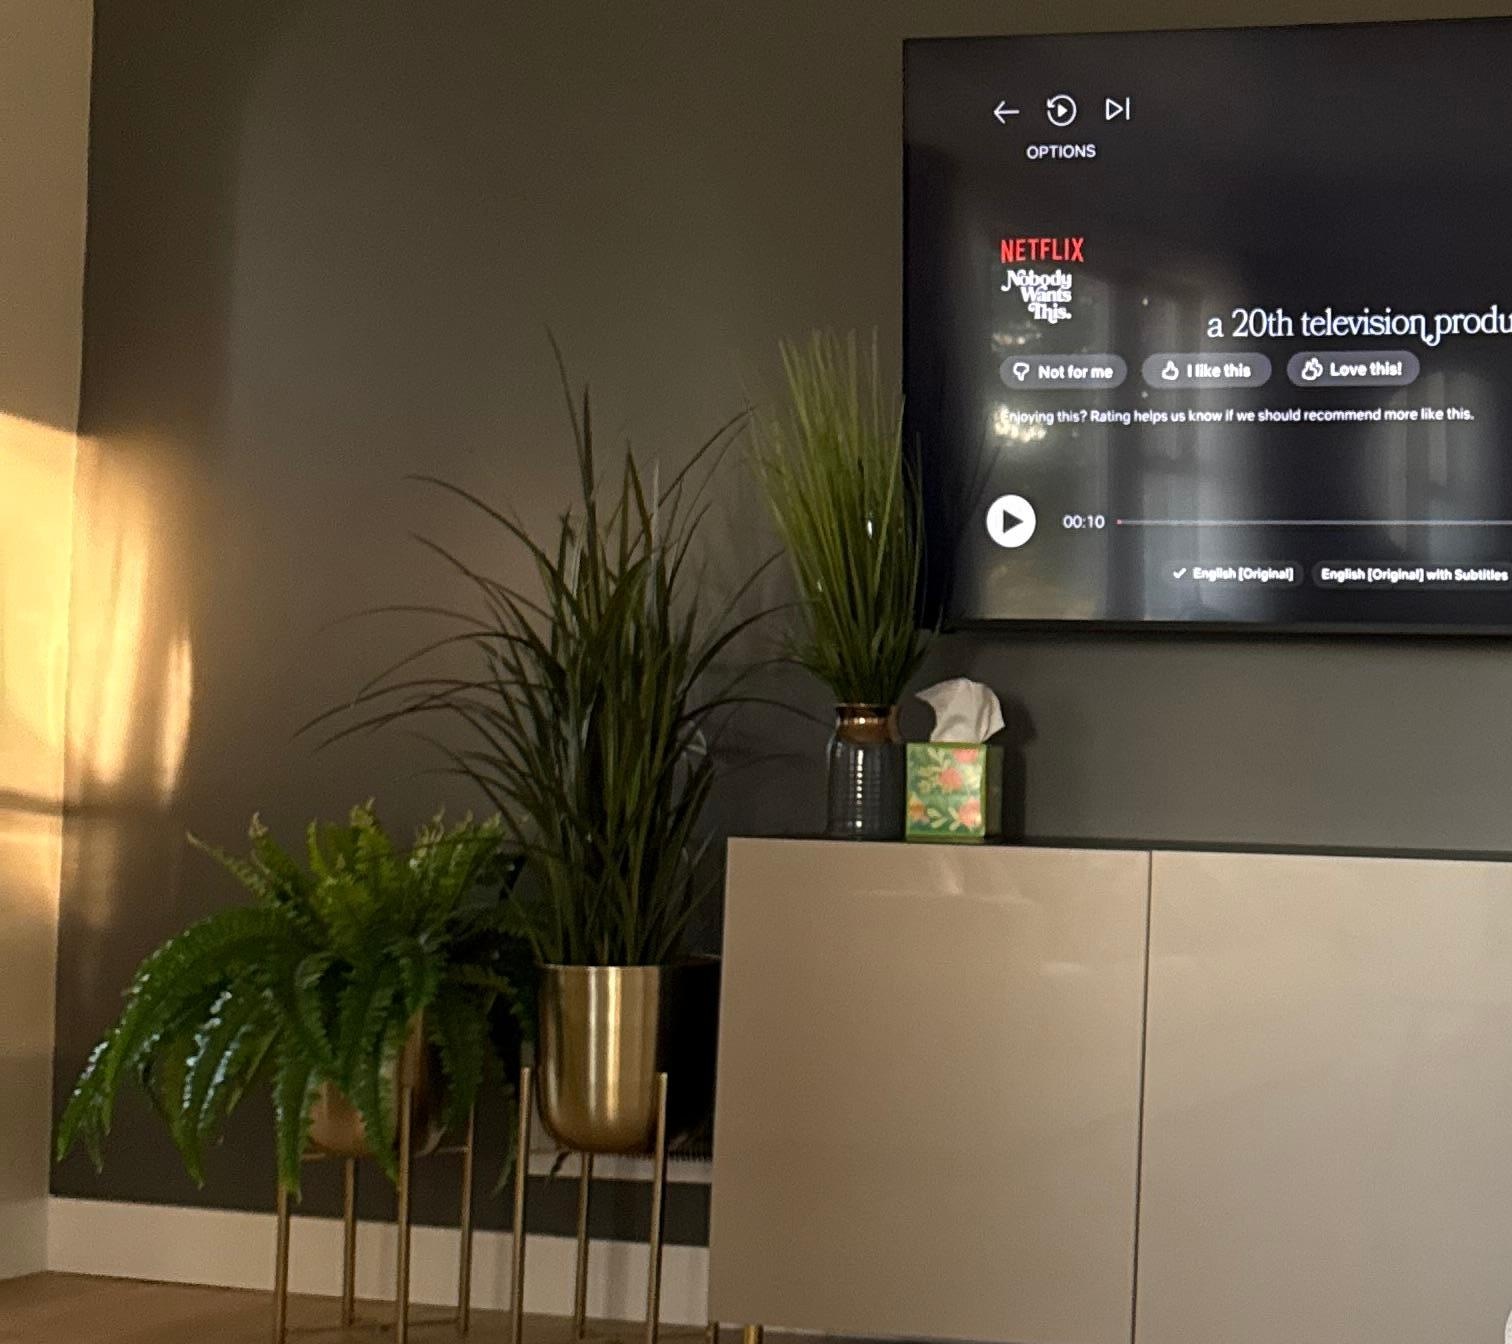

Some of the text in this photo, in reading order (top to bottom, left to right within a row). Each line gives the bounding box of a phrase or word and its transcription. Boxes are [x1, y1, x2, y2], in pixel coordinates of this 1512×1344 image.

[1026, 143, 1097, 159] OPTIONS
[1000, 237, 1084, 264] NETFLIX
[1000, 268, 1073, 292] Nobody
[1020, 286, 1073, 303] Wants
[1027, 302, 1073, 324] This.
[1206, 316, 1224, 338] a
[1231, 307, 1294, 338] 20th
[1300, 307, 1433, 344] television
[1038, 364, 1113, 379] Not for me
[1186, 363, 1252, 378] I like this
[1329, 361, 1403, 377] Love this!
[1056, 409, 1088, 423] this?
[1090, 409, 1131, 425] Rating
[1134, 409, 1168, 424] helps
[1171, 411, 1186, 423] us
[1188, 409, 1222, 423] know
[1225, 408, 1234, 422] if
[1236, 411, 1255, 422] we
[1257, 408, 1301, 422] should
[1303, 408, 1381, 422] recommend
[1384, 409, 1418, 421] more
[1420, 407, 1444, 421] like
[1446, 407, 1475, 421] this.
[1063, 514, 1105, 529] 00:10
[1192, 567, 1294, 582] English [Original]
[1321, 567, 1509, 582] English [Original] with Subtitles
